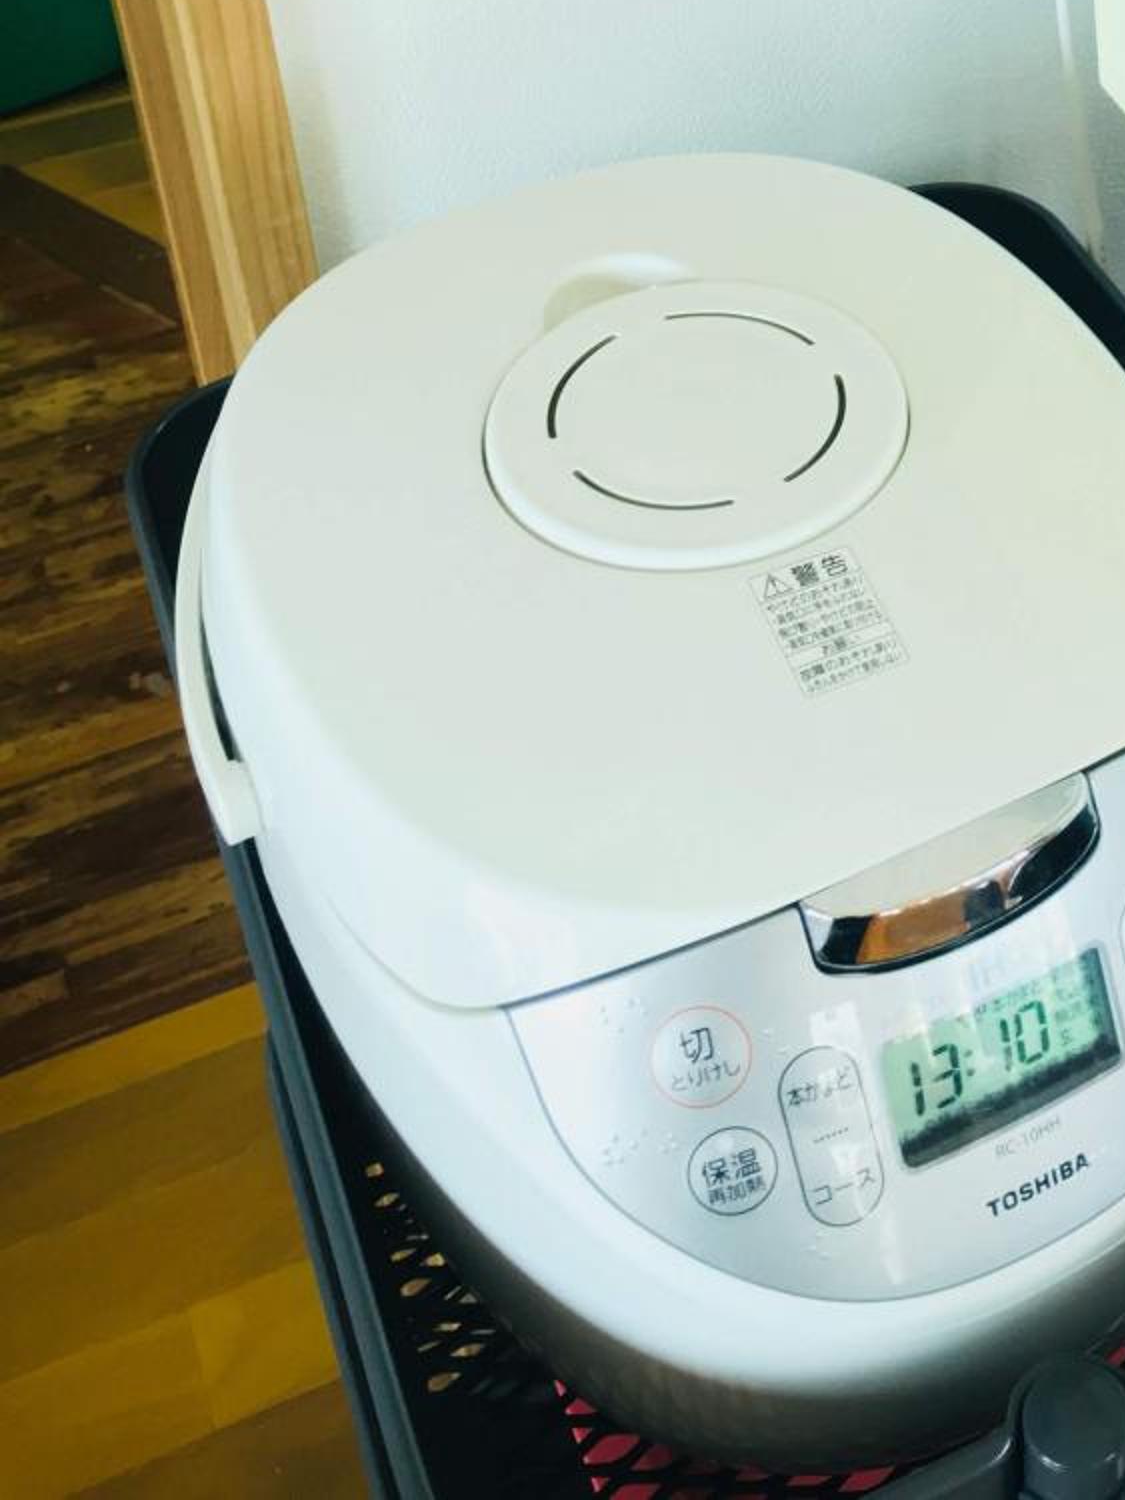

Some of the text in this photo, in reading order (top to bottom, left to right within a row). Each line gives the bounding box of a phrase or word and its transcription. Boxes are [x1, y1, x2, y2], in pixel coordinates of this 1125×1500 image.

[679, 1026, 716, 1065] 切
[910, 1000, 1049, 1118] 13:10
[671, 1060, 742, 1092] とりけし
[701, 1147, 763, 1188] 保温
[811, 1167, 877, 1205] コース
[985, 1152, 1090, 1218] TOSHIBA
